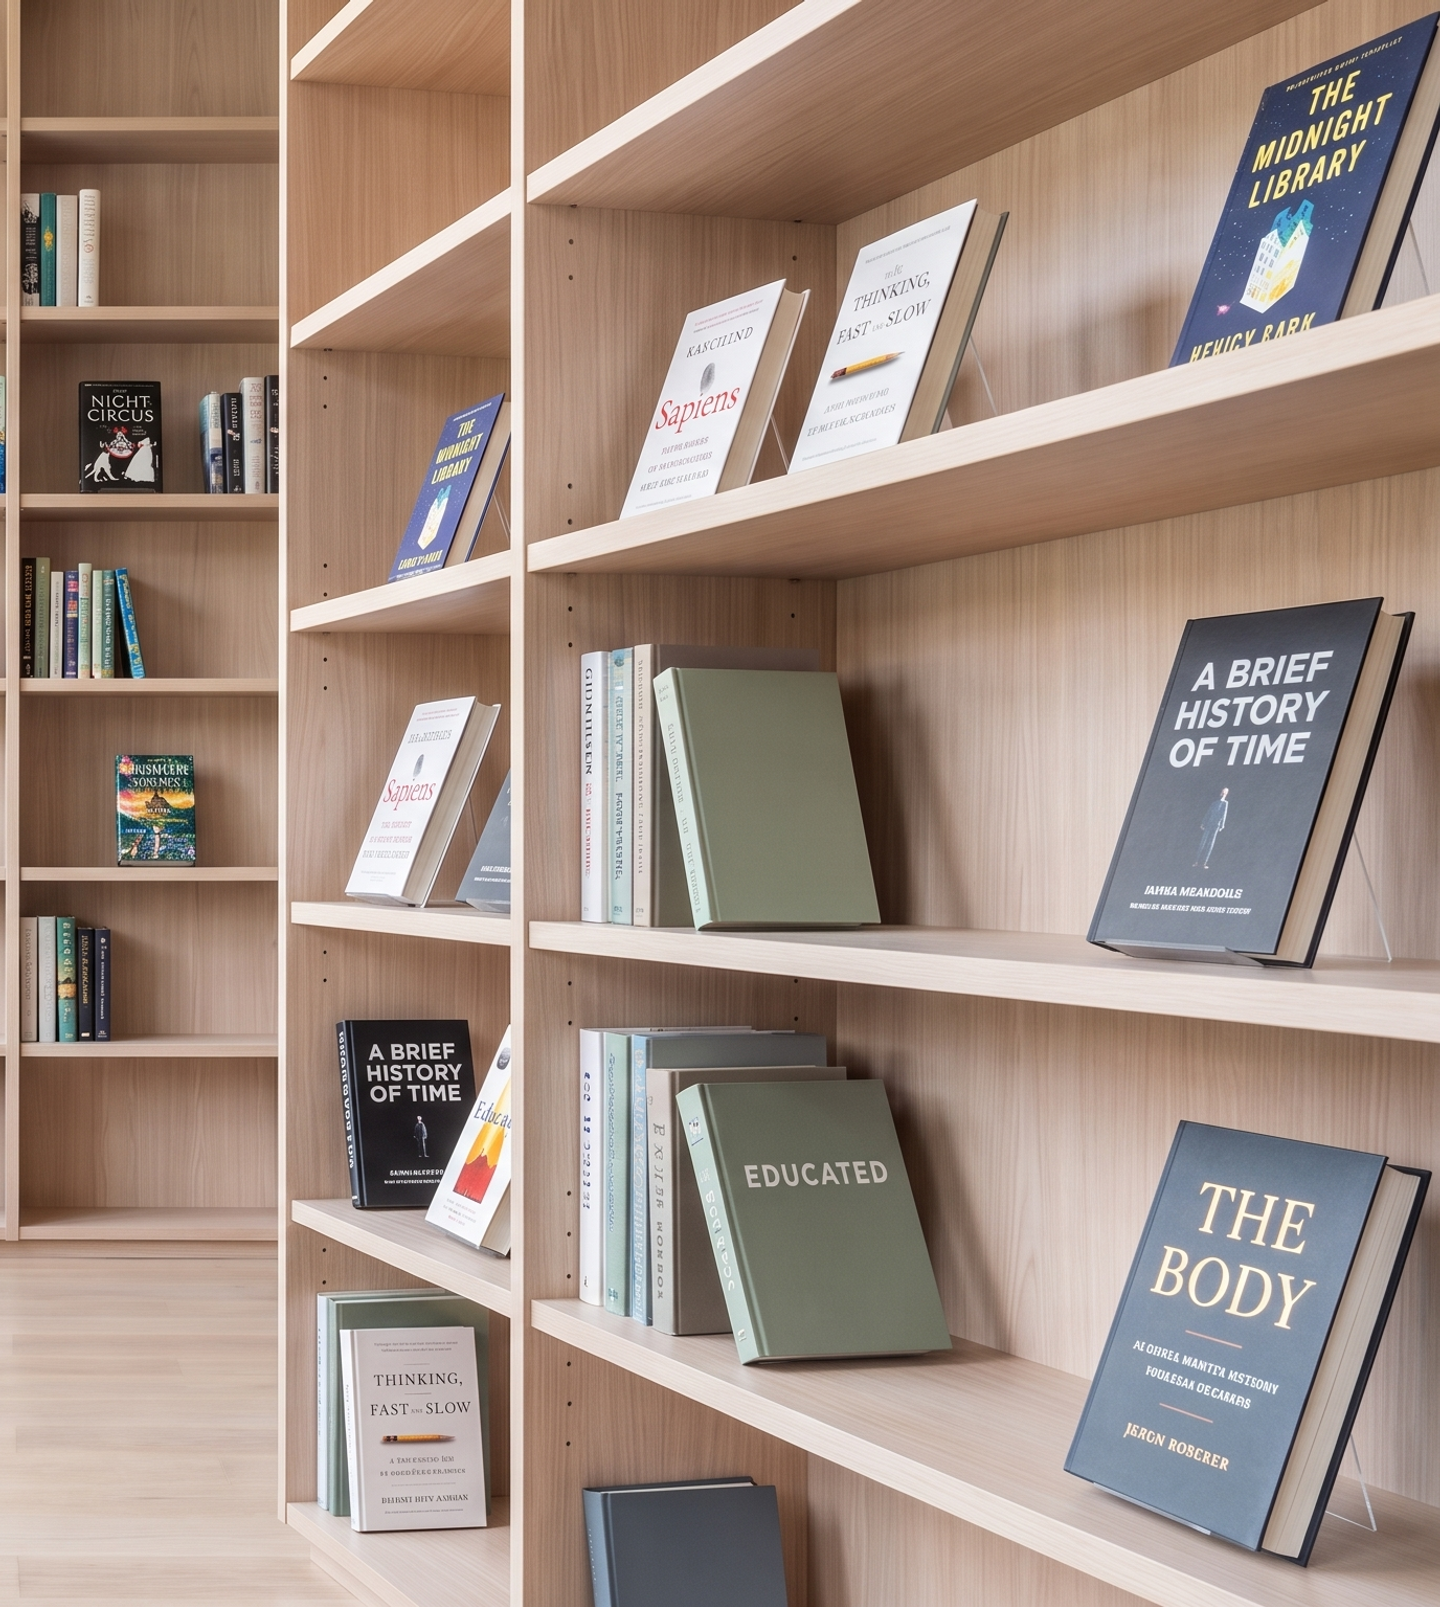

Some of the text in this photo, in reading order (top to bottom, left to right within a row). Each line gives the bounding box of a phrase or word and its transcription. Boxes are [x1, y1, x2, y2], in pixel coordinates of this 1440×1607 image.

[1310, 71, 1360, 115] THE
[1252, 93, 1392, 173] MIDNIGHT
[1248, 140, 1366, 208] LIBRARY
[853, 271, 930, 311] THINKING,
[836, 299, 931, 345] FAST SLOW
[87, 409, 154, 422] CIRCUS
[655, 387, 740, 434] Sapiens
[1191, 650, 1334, 691] A BRIEF
[1174, 690, 1330, 730] HISTORY
[1169, 732, 1311, 768] OF TIME
[383, 778, 436, 811] Sapiens
[369, 1043, 455, 1060] A BRIEF
[367, 1064, 462, 1082] HISTORY
[370, 1084, 461, 1103] OF TIME
[744, 1160, 888, 1188] EDUCATED
[1198, 1181, 1316, 1255] THE
[1150, 1245, 1317, 1331] BODY
[374, 1372, 463, 1387] THINKING,
[370, 1403, 410, 1416] FAST
[426, 1401, 471, 1414] SLOW
